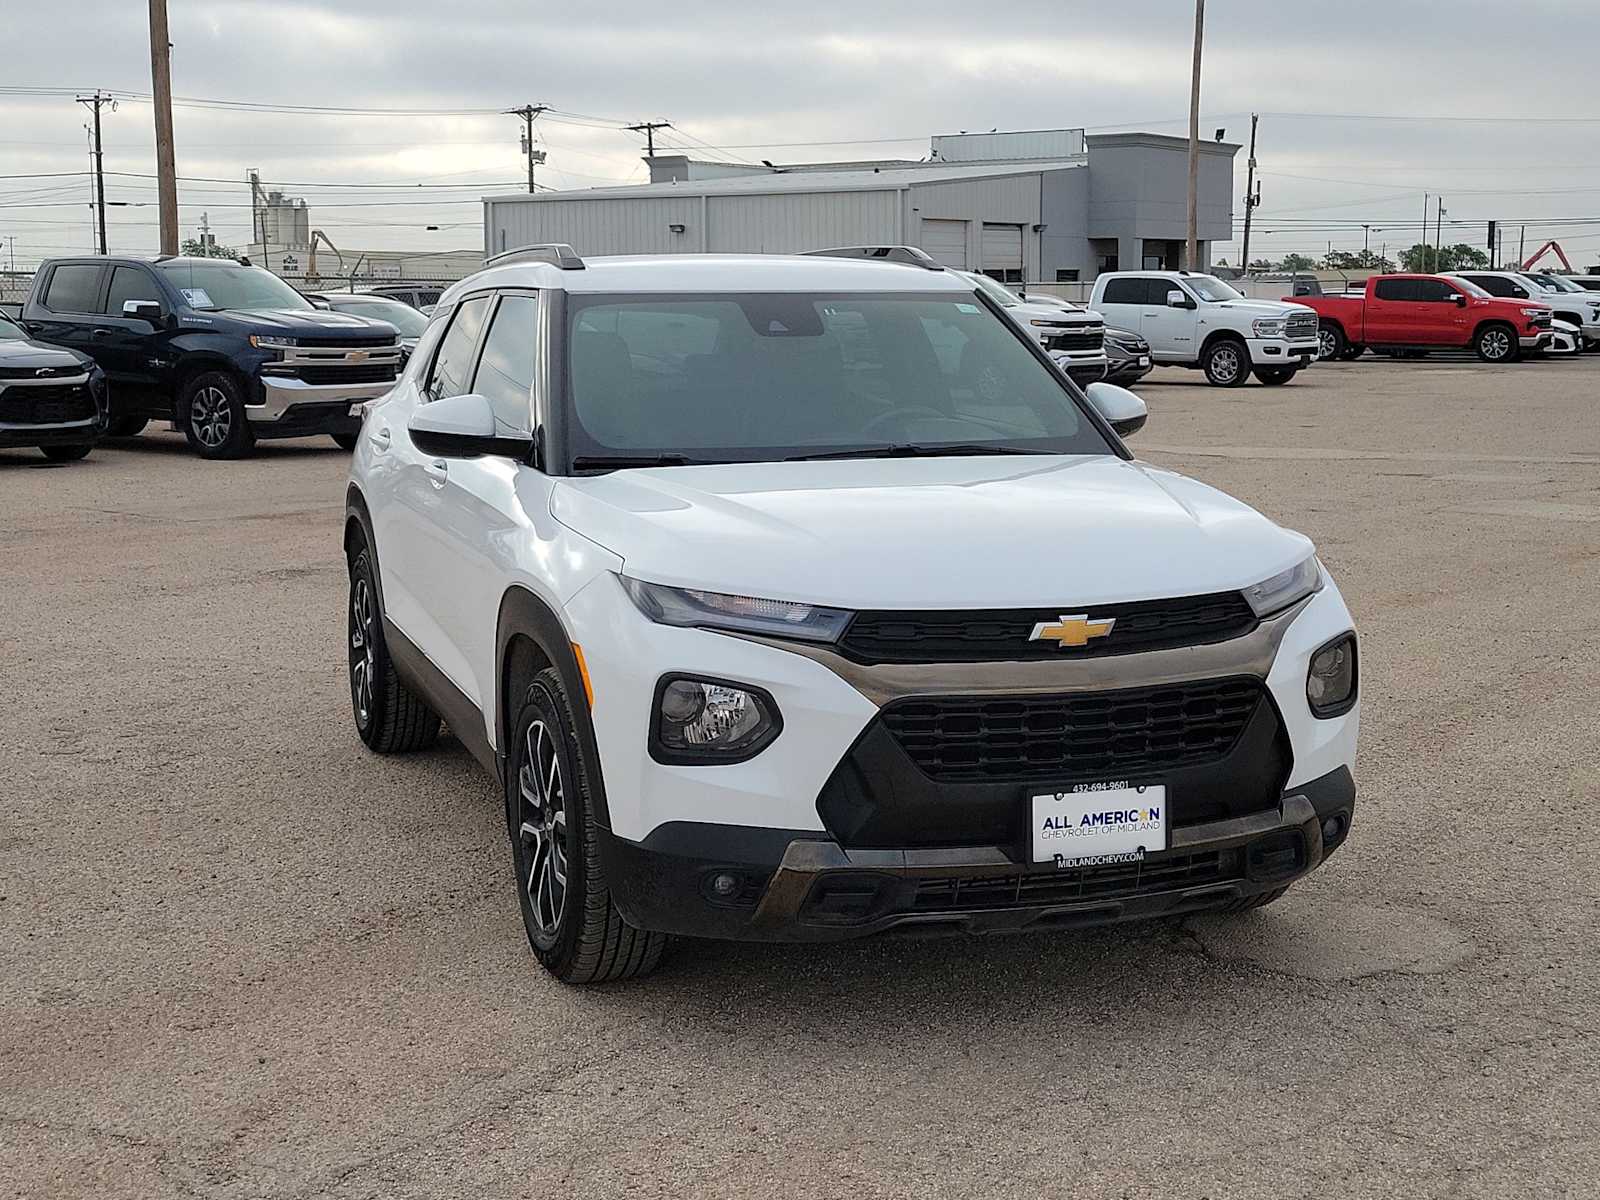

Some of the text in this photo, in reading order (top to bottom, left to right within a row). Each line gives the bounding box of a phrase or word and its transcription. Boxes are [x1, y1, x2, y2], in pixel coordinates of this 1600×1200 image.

[1072, 781, 1129, 793] 432-694-9601
[1041, 820, 1161, 840] CHEVROLET OF MIDLAND
[1042, 815, 1073, 830] ALL
[1057, 852, 1145, 869] MIDLANDCHEVY.COM
